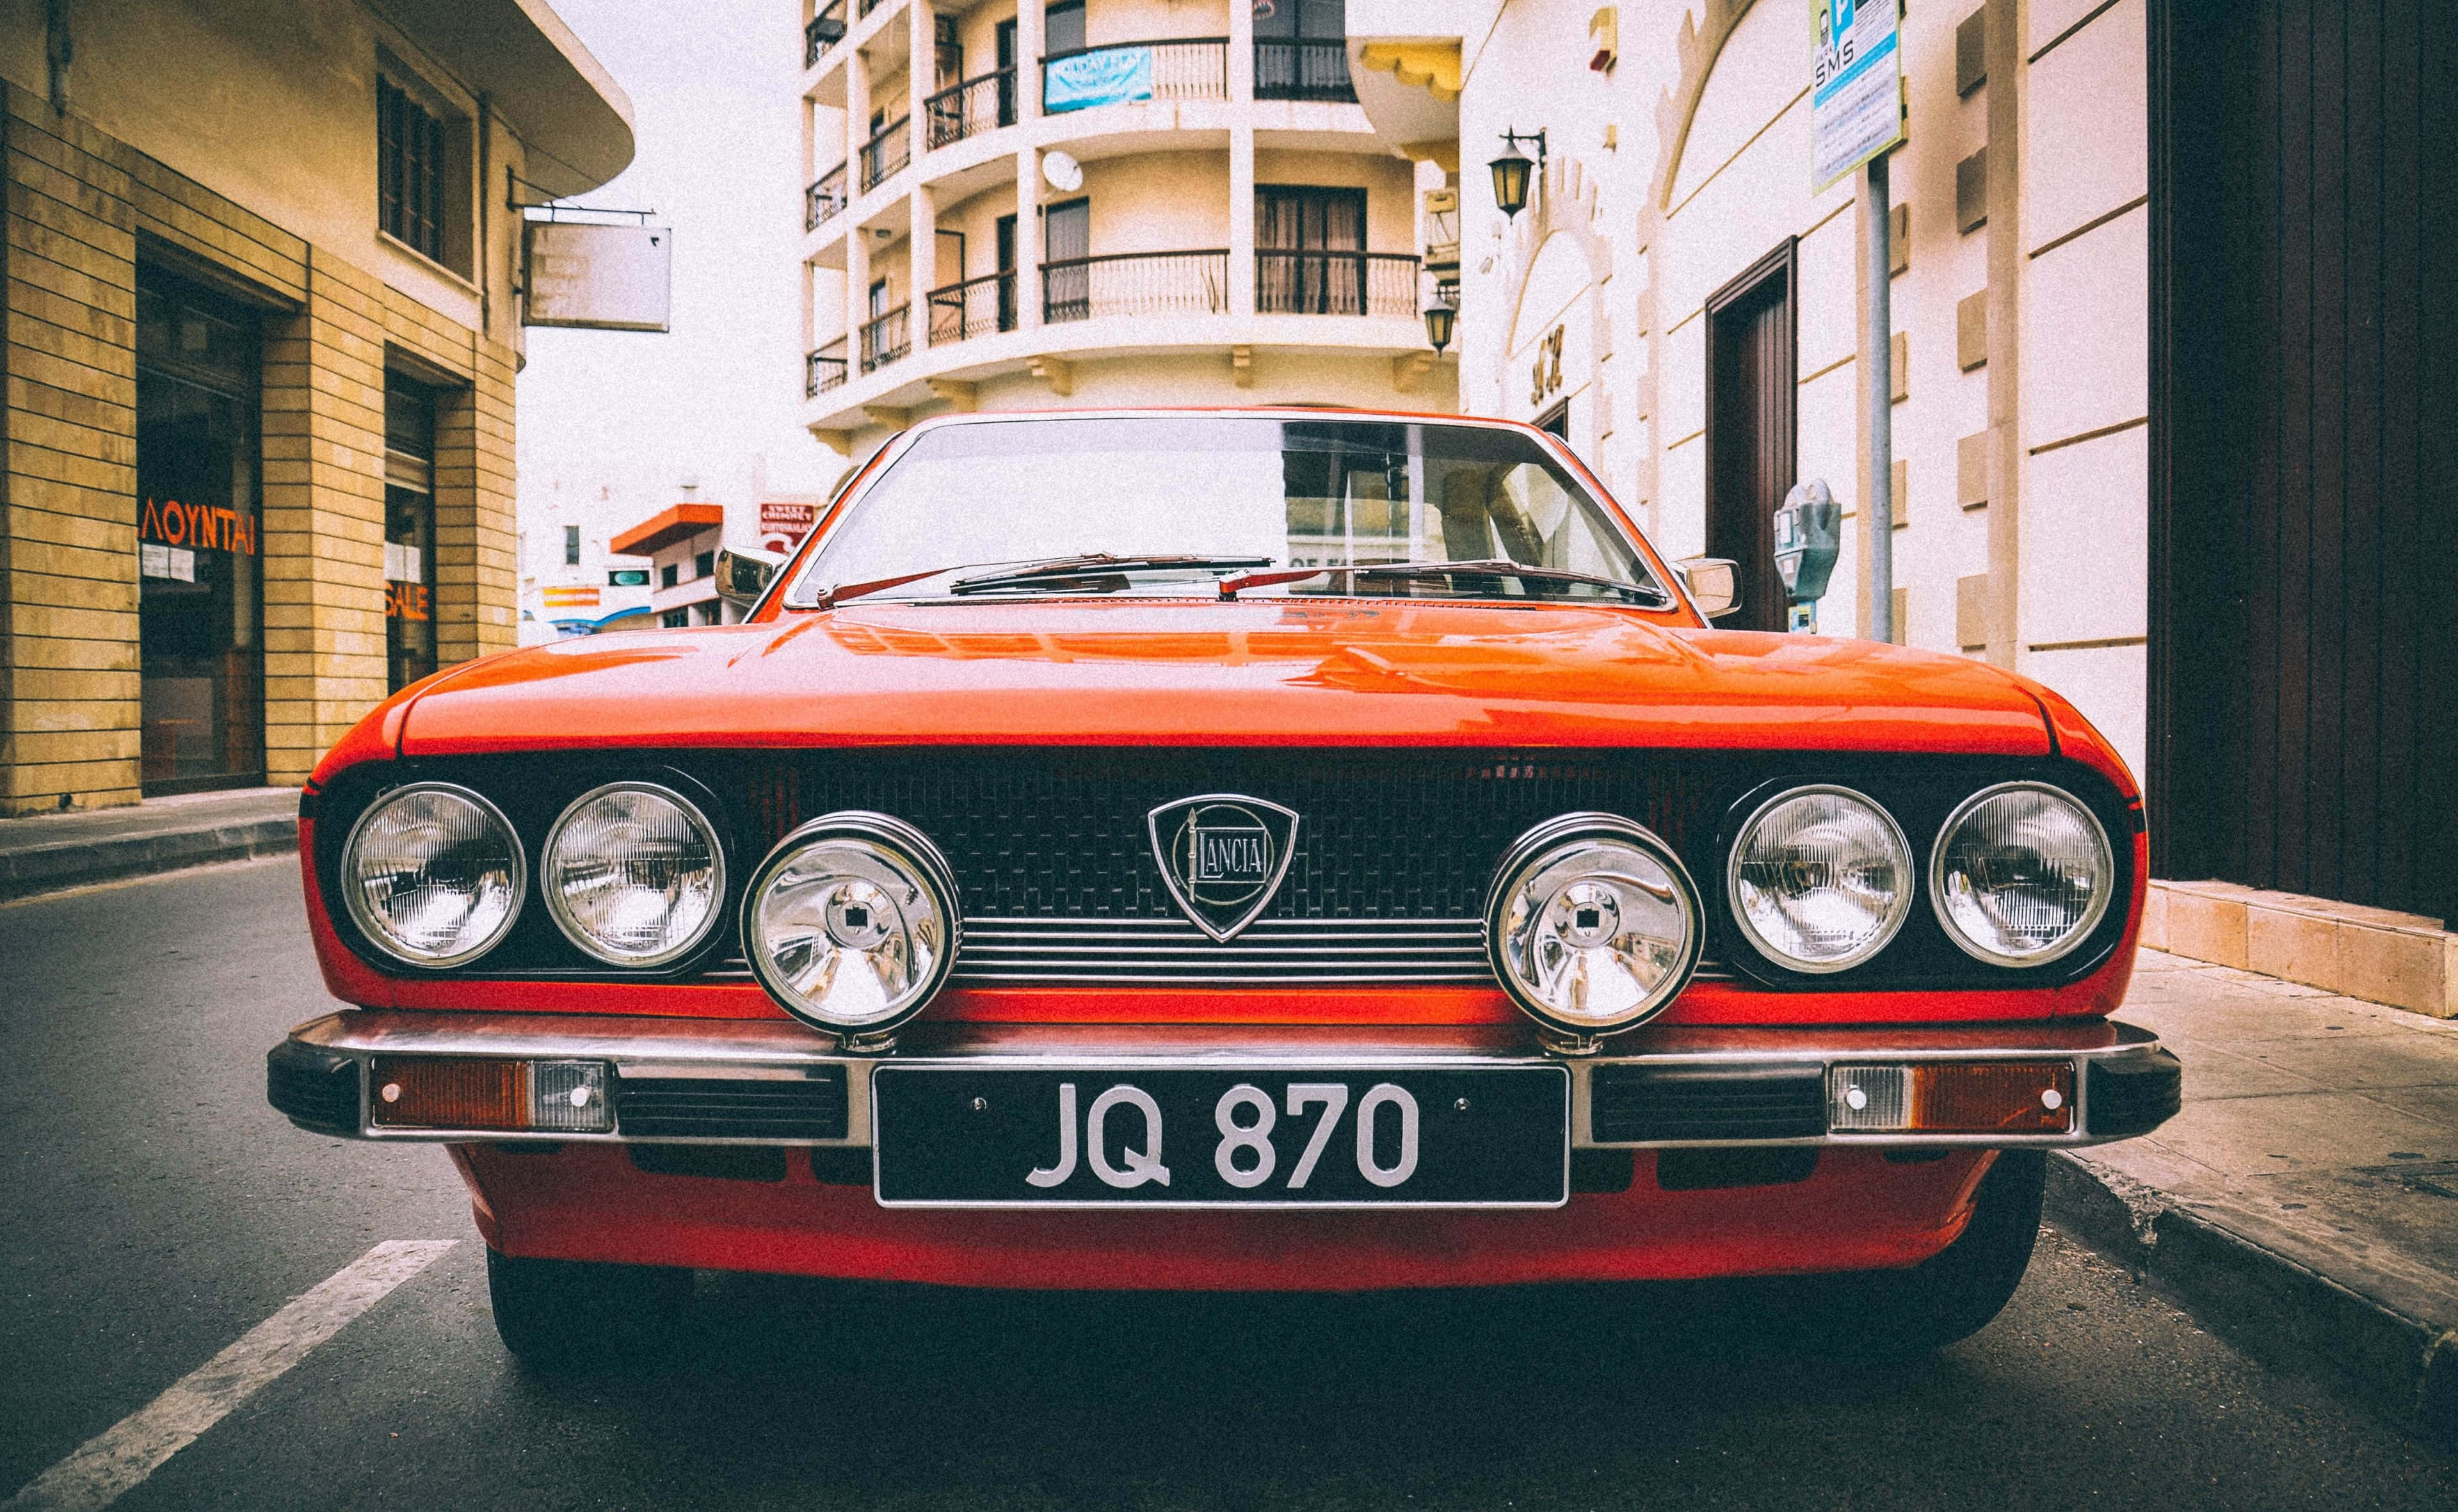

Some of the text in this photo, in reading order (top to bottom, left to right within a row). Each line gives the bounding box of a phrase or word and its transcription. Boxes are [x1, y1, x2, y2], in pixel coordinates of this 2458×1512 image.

[1816, 40, 1854, 87] SMS
[138, 496, 255, 556] ΛΟΥΝΤΑΙ
[762, 511, 812, 521] CHIMNEY
[384, 581, 429, 620] SALE
[1199, 833, 1262, 878] LANCIA
[1025, 1082, 1418, 1189] JQ 870
